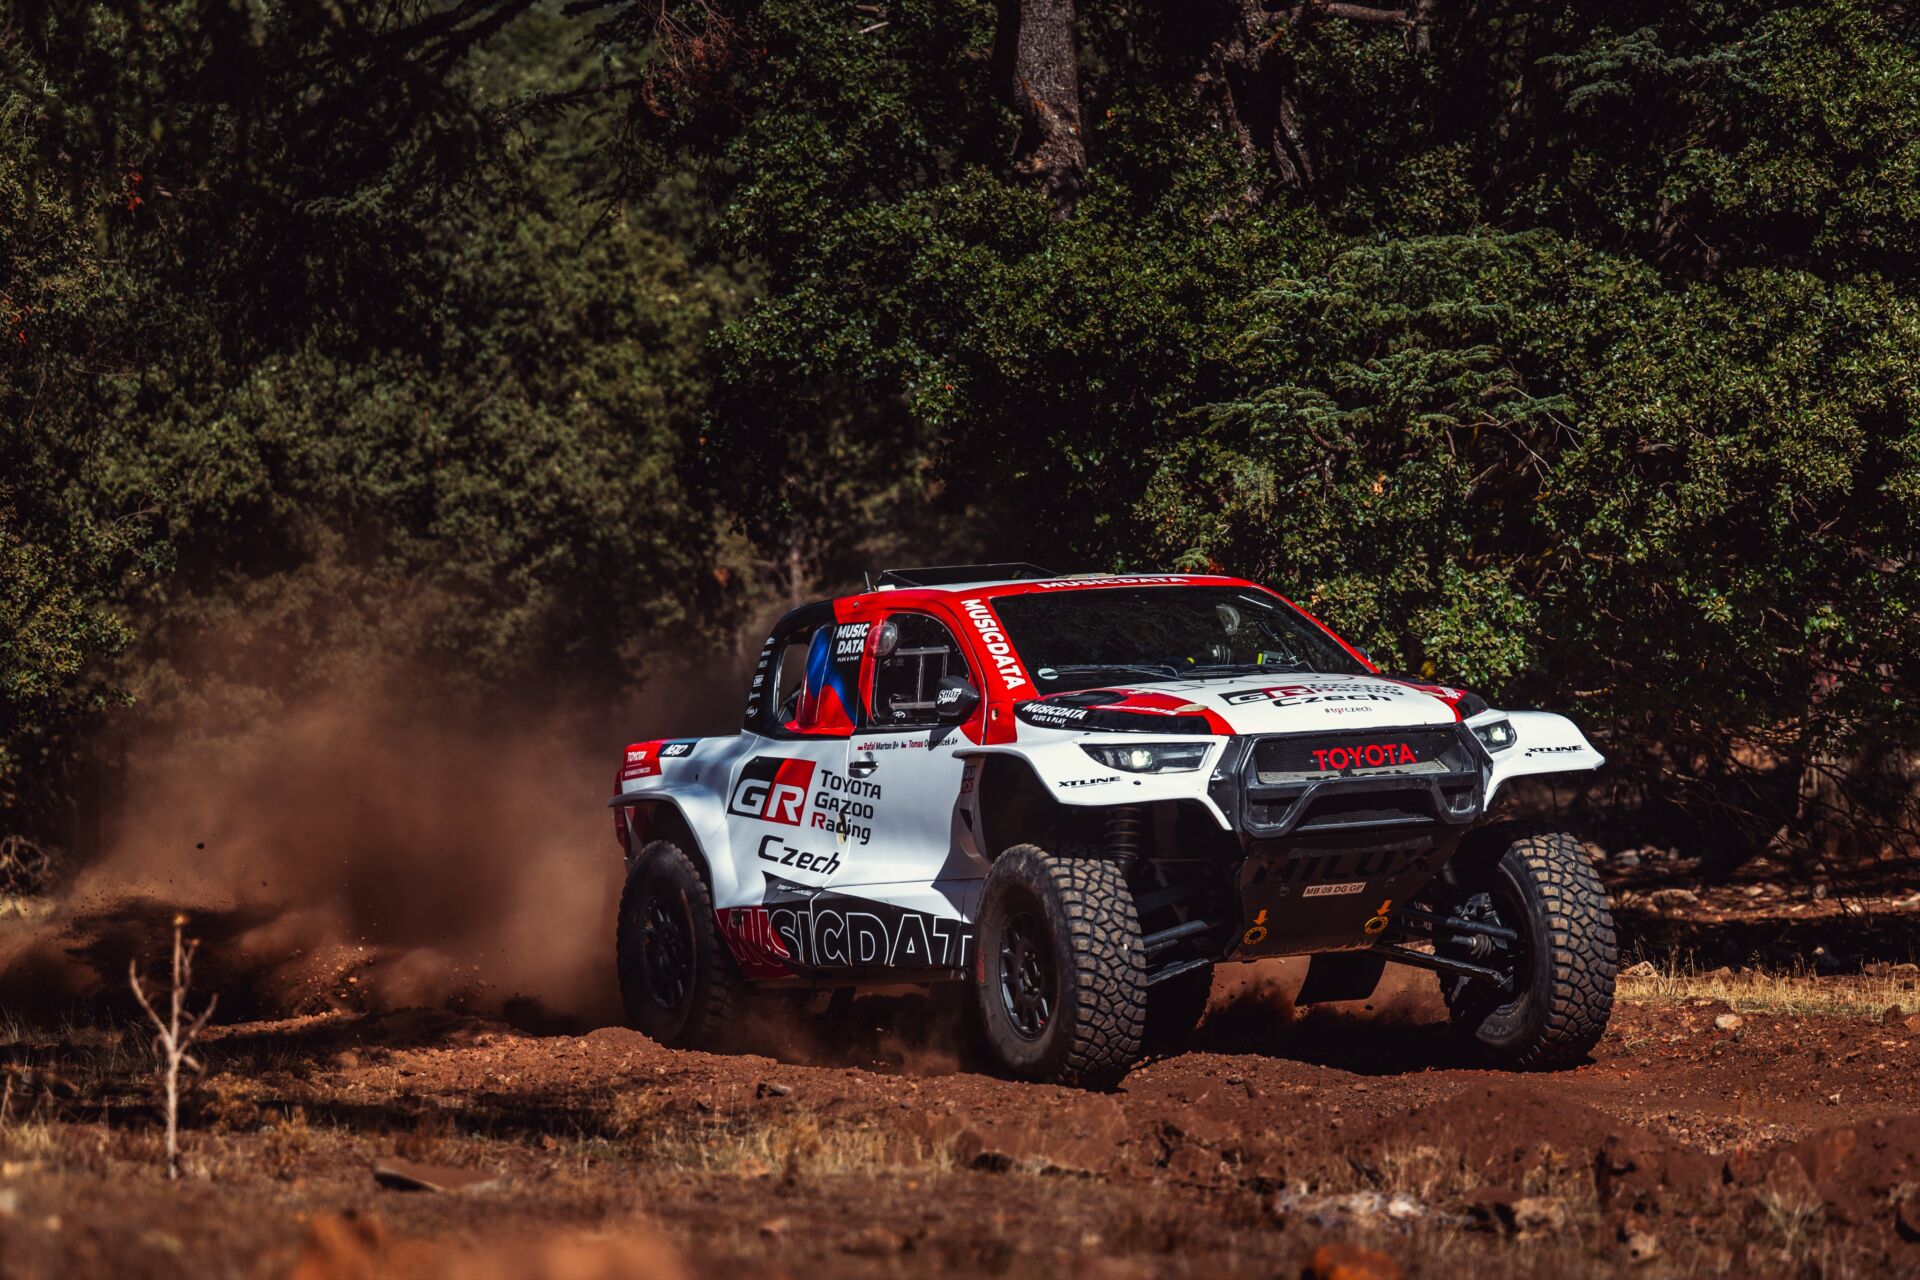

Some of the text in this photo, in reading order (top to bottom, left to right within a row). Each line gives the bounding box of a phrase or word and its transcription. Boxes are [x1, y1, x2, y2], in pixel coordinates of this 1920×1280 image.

[1036, 577, 1190, 588] MUSICDATA
[836, 623, 870, 639] MUSIC
[836, 639, 865, 654] DATA
[960, 598, 1026, 690] MUSICDATA
[1219, 686, 1315, 706] GR
[1272, 694, 1392, 707] Czech
[1022, 703, 1088, 720] MUSICDATA
[1324, 705, 1373, 715] #tgrczech
[1051, 716, 1066, 724] PLAY
[1312, 743, 1417, 771] TOYOTA
[1528, 745, 1583, 753] XTLINE
[820, 769, 882, 800] TOYOTA
[1058, 775, 1121, 787] XTLINE
[732, 778, 806, 822] GR
[814, 791, 874, 820] GAZOO
[810, 811, 872, 846] Racing
[757, 834, 841, 875] Czech
[722, 908, 974, 967] MUSICDAT
